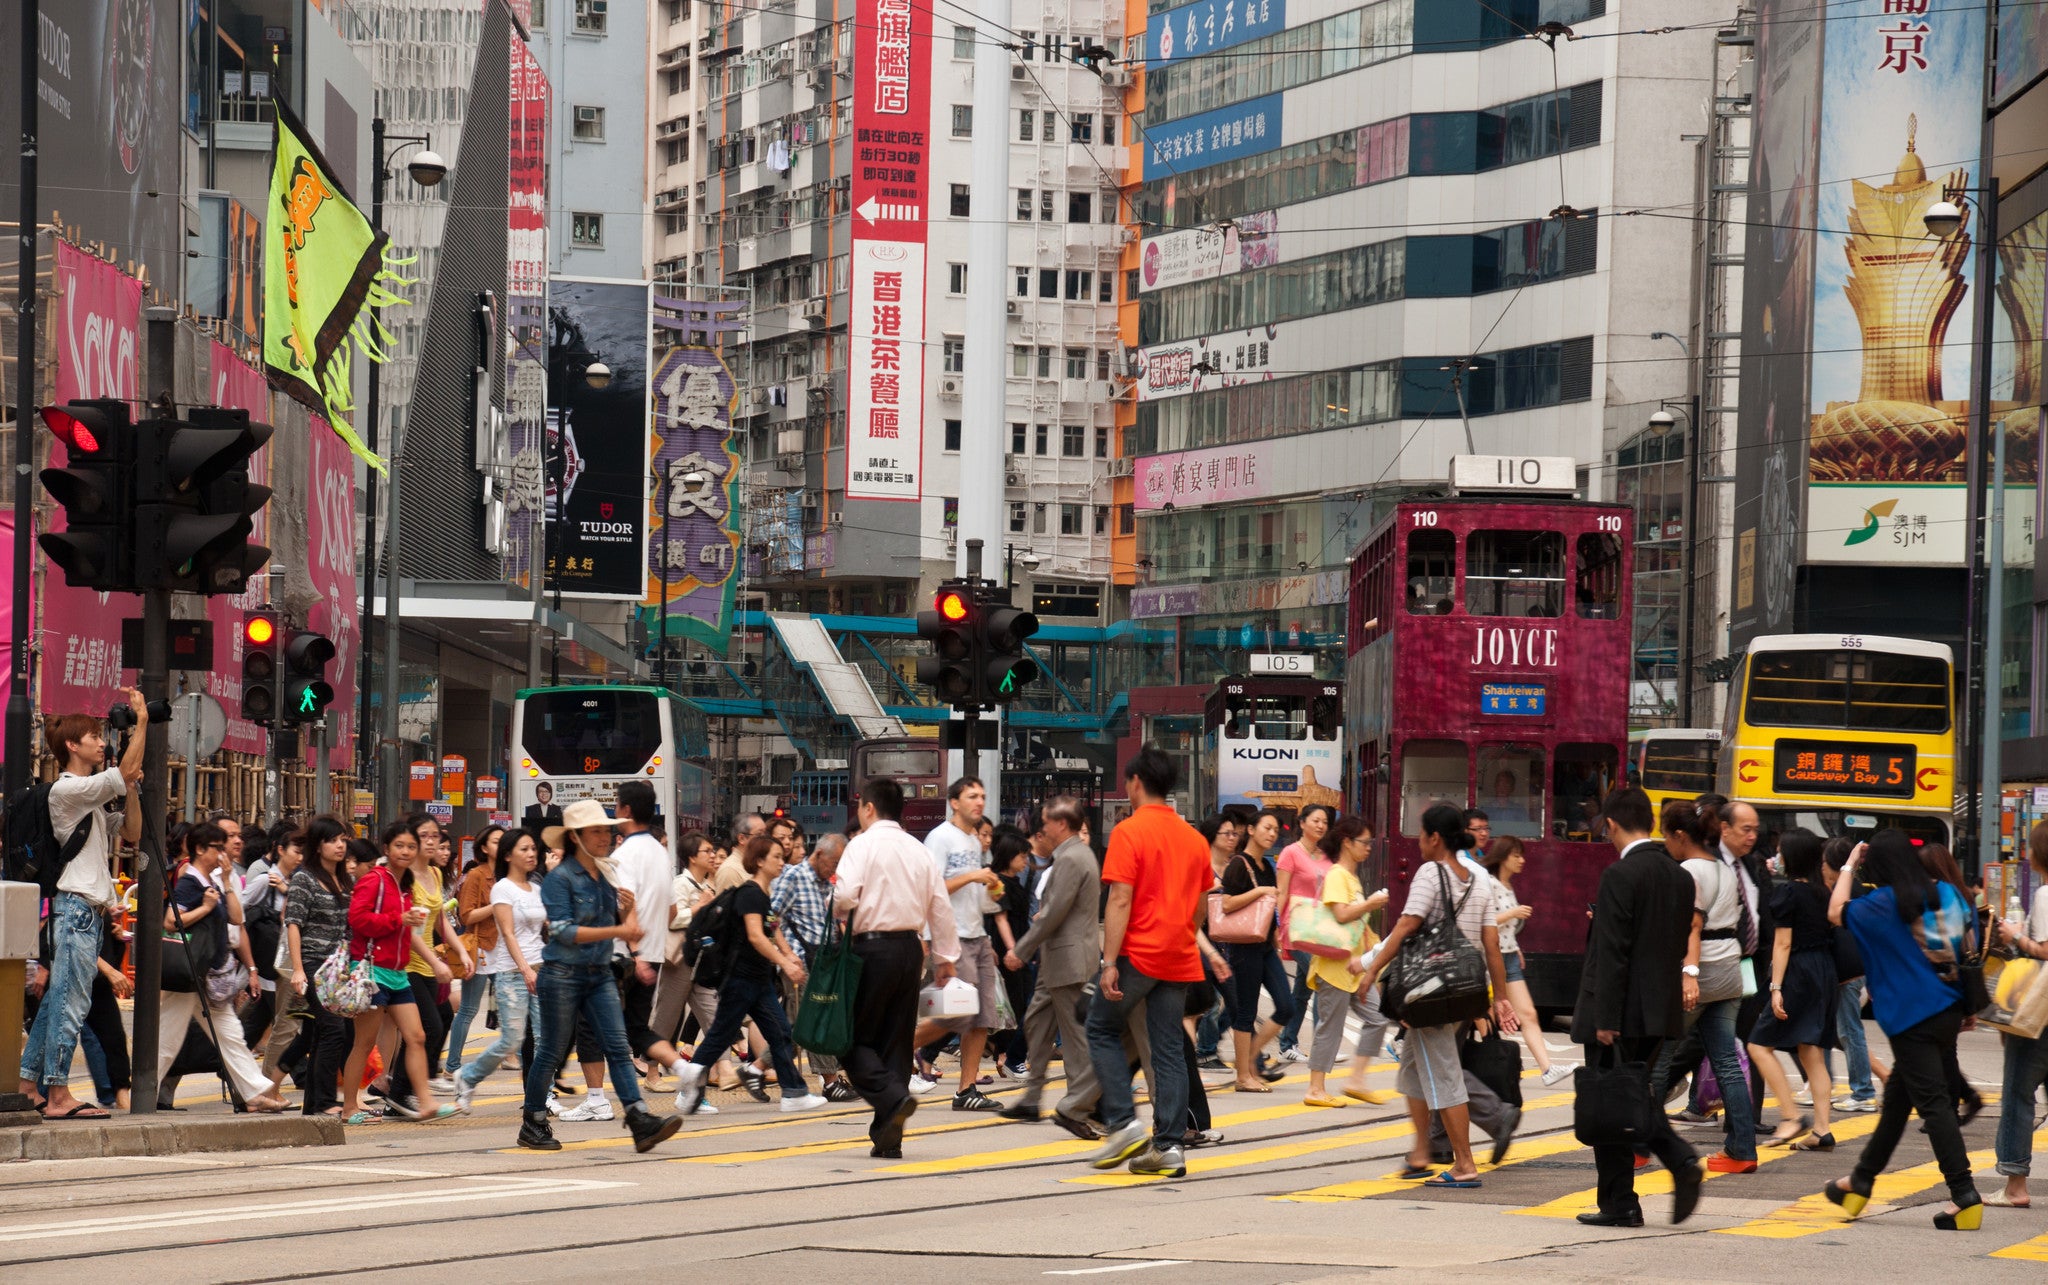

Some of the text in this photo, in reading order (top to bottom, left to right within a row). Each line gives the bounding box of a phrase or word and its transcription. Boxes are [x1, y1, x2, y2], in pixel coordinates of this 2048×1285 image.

[1245, 0, 1269, 27] 飯店
[1878, 0, 1930, 73] 京
[876, 0, 911, 113] 旗艦店
[857, 128, 924, 146] 請在此向左
[1153, 129, 1204, 165] 正宗客家菜
[860, 147, 921, 165] 步行30秒
[863, 167, 917, 183] 即可到達
[869, 271, 902, 439] 香港茶餐廳
[1172, 453, 1256, 494] 婚宴專門店
[1497, 459, 1541, 484] 110
[1412, 511, 1438, 526] 110
[1596, 516, 1622, 531] 110
[1893, 514, 1927, 530] 澳博
[580, 521, 633, 534] TUDOR
[1893, 532, 1926, 547] SJM
[1471, 628, 1558, 667] JOYCE
[1841, 638, 1863, 648] 555
[1267, 656, 1299, 670] 105
[211, 671, 222, 696] The
[1227, 685, 1243, 694] 105
[1322, 687, 1337, 695] 105
[1483, 684, 1546, 695] Shaukeiwan
[1233, 748, 1299, 760] KUONI
[1797, 752, 1871, 772] 銅鑼灣
[584, 756, 600, 773] 8P
[1886, 758, 1904, 784] 5
[1786, 768, 1880, 784] Causeway Bay
[429, 806, 451, 814] 23 23A
